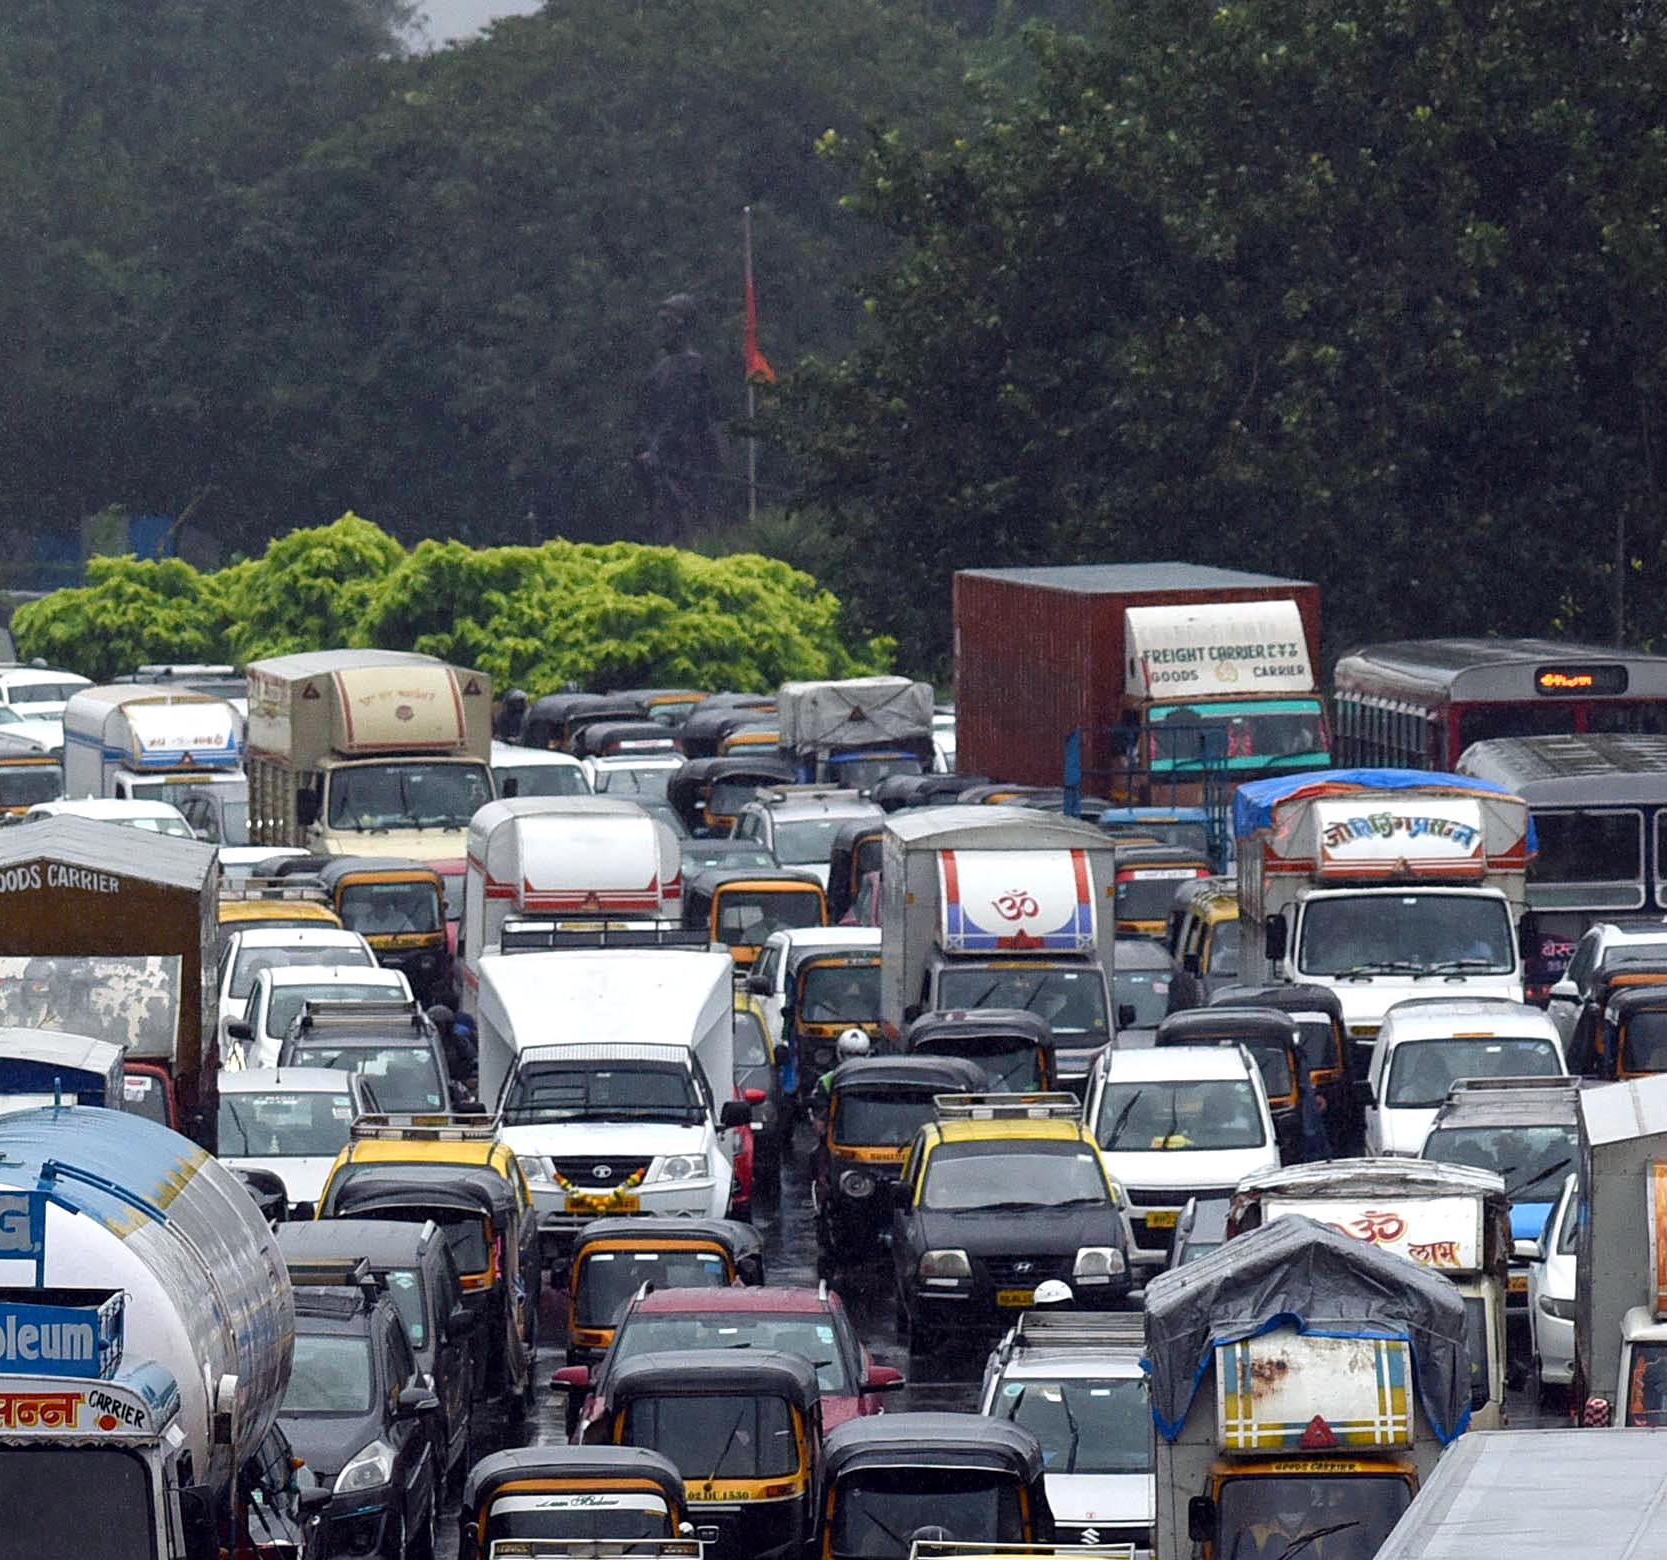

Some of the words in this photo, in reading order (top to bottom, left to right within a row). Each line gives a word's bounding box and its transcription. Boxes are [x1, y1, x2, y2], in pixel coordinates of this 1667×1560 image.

[1143, 647, 1206, 665] FREIGHT
[1209, 645, 1268, 664] CARRIER
[1151, 670, 1199, 682] GOODS
[1253, 664, 1305, 679] CARRIER
[47, 864, 120, 894] CARRIER
[88, 1389, 145, 1429] CARRIER
